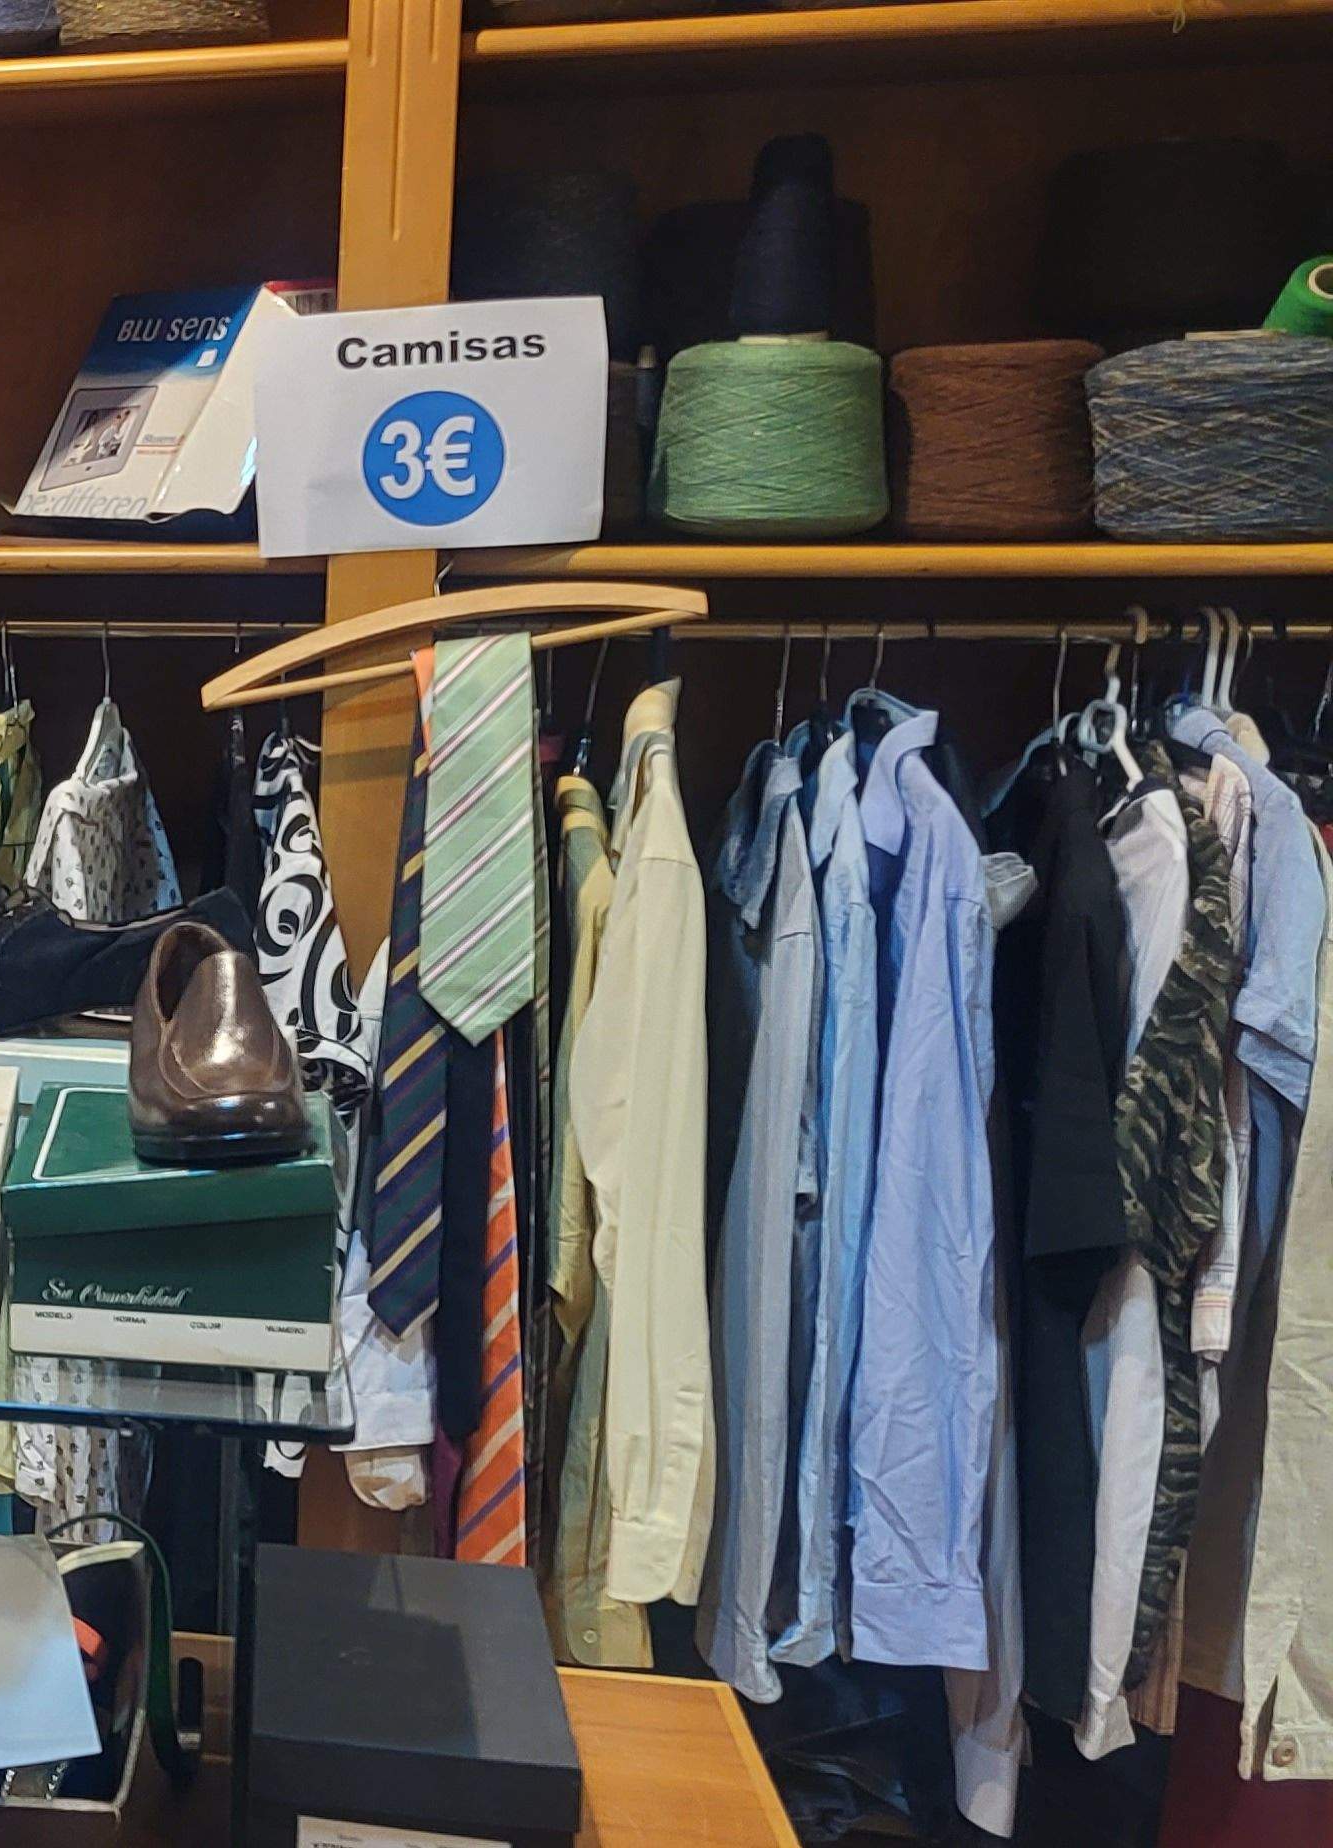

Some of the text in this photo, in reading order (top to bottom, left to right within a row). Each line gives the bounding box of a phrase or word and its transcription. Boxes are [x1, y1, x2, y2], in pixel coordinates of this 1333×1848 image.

[117, 315, 233, 343] BLU sens
[337, 331, 546, 370] Camisas
[379, 416, 476, 500] 3€
